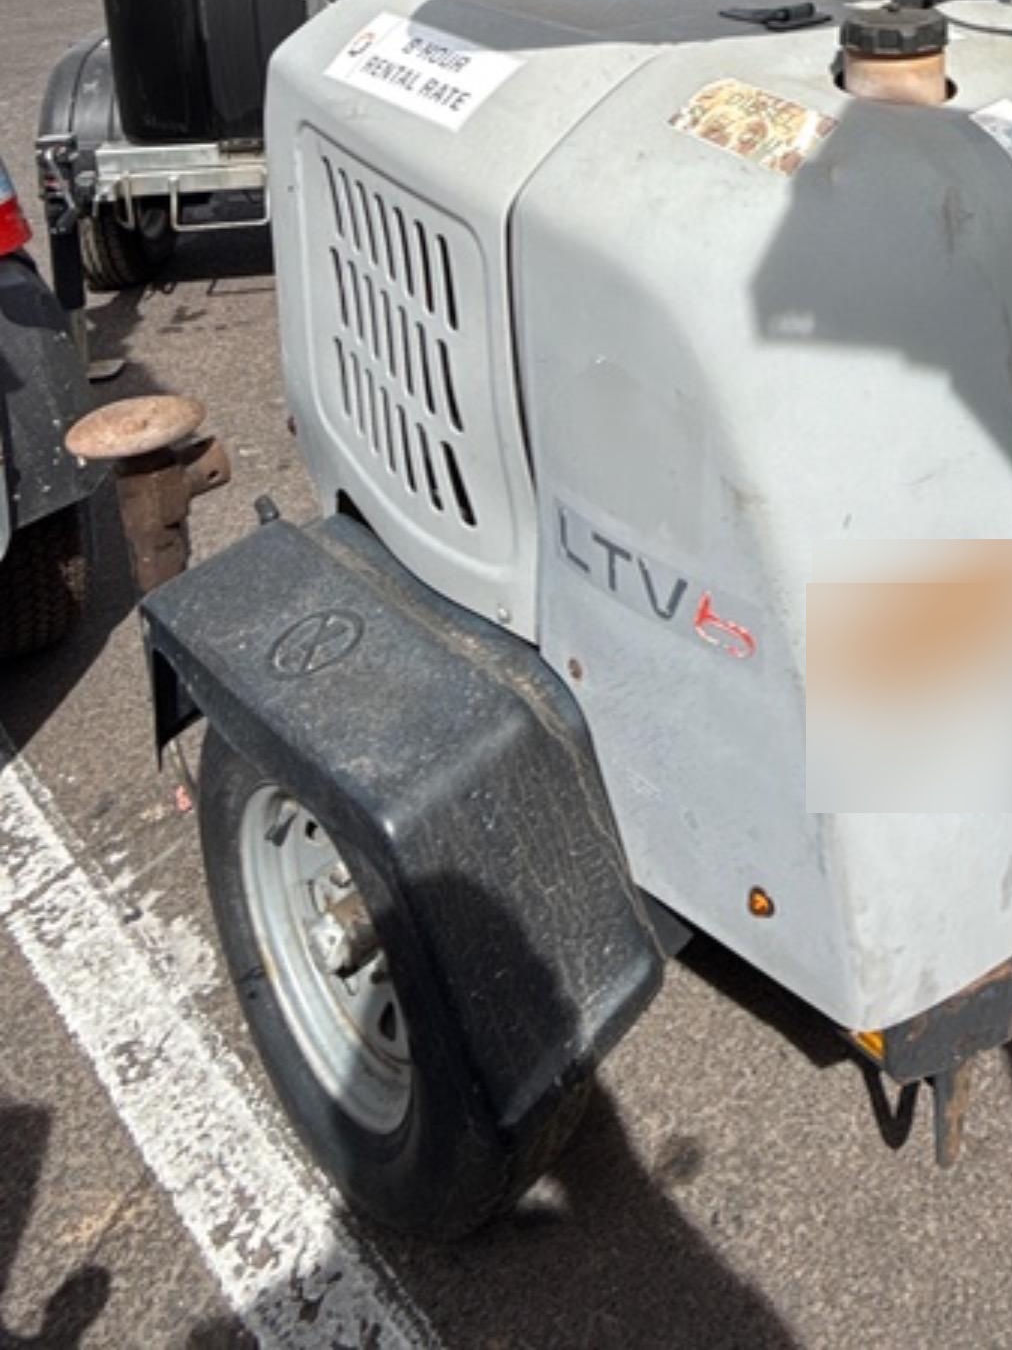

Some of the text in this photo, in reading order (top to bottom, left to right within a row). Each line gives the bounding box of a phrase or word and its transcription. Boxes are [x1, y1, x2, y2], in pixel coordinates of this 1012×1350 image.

[416, 43, 472, 73] HOUR
[359, 54, 472, 112] RENTAL RATE
